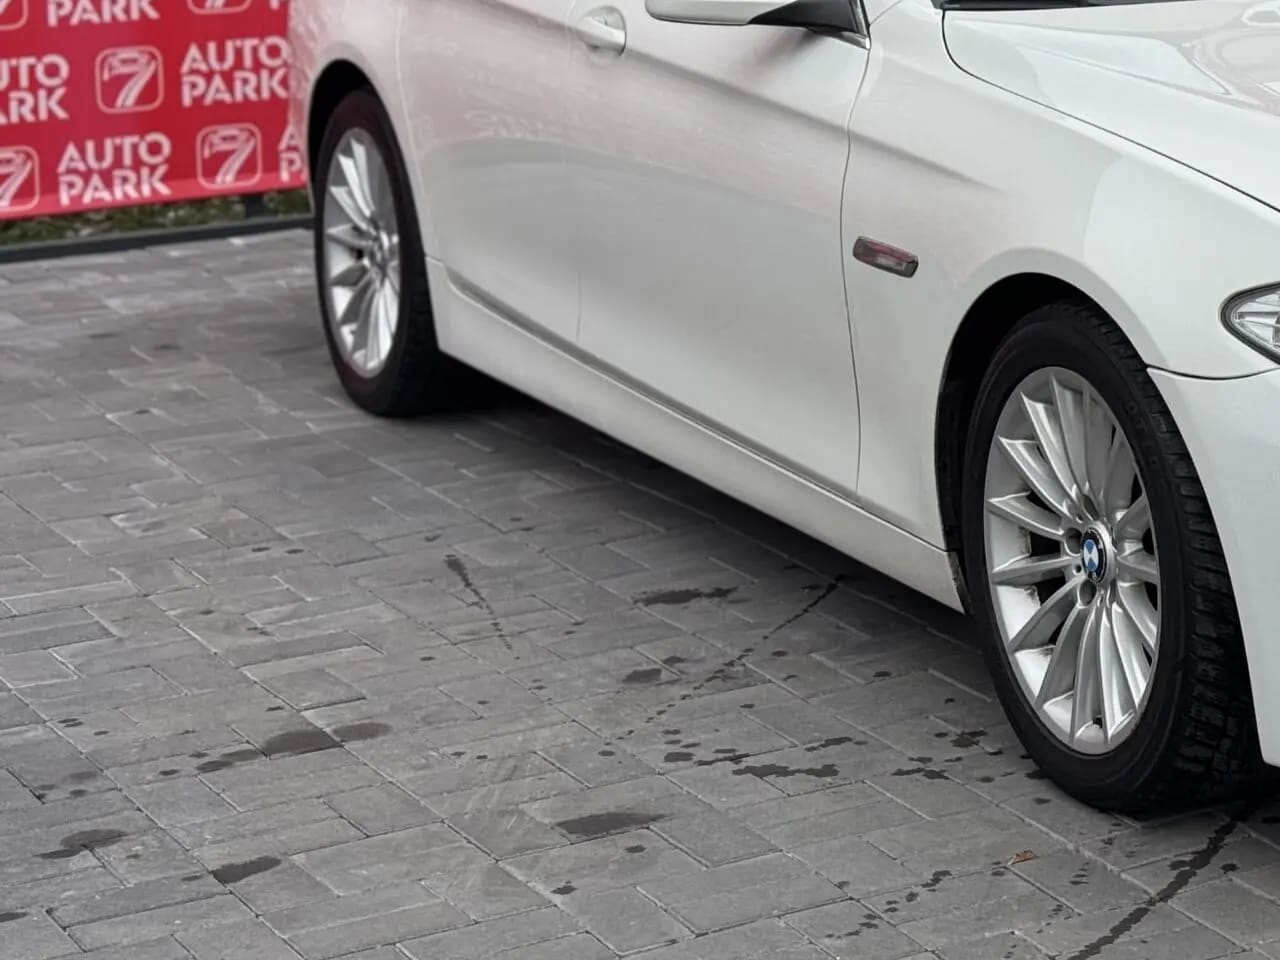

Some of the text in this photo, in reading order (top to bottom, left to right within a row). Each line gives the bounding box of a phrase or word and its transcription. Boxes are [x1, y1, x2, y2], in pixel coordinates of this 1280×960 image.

[181, 36, 291, 76] AUTO
[181, 66, 289, 108] PARK
[57, 132, 171, 174] AUTO
[58, 164, 172, 201] PARK
